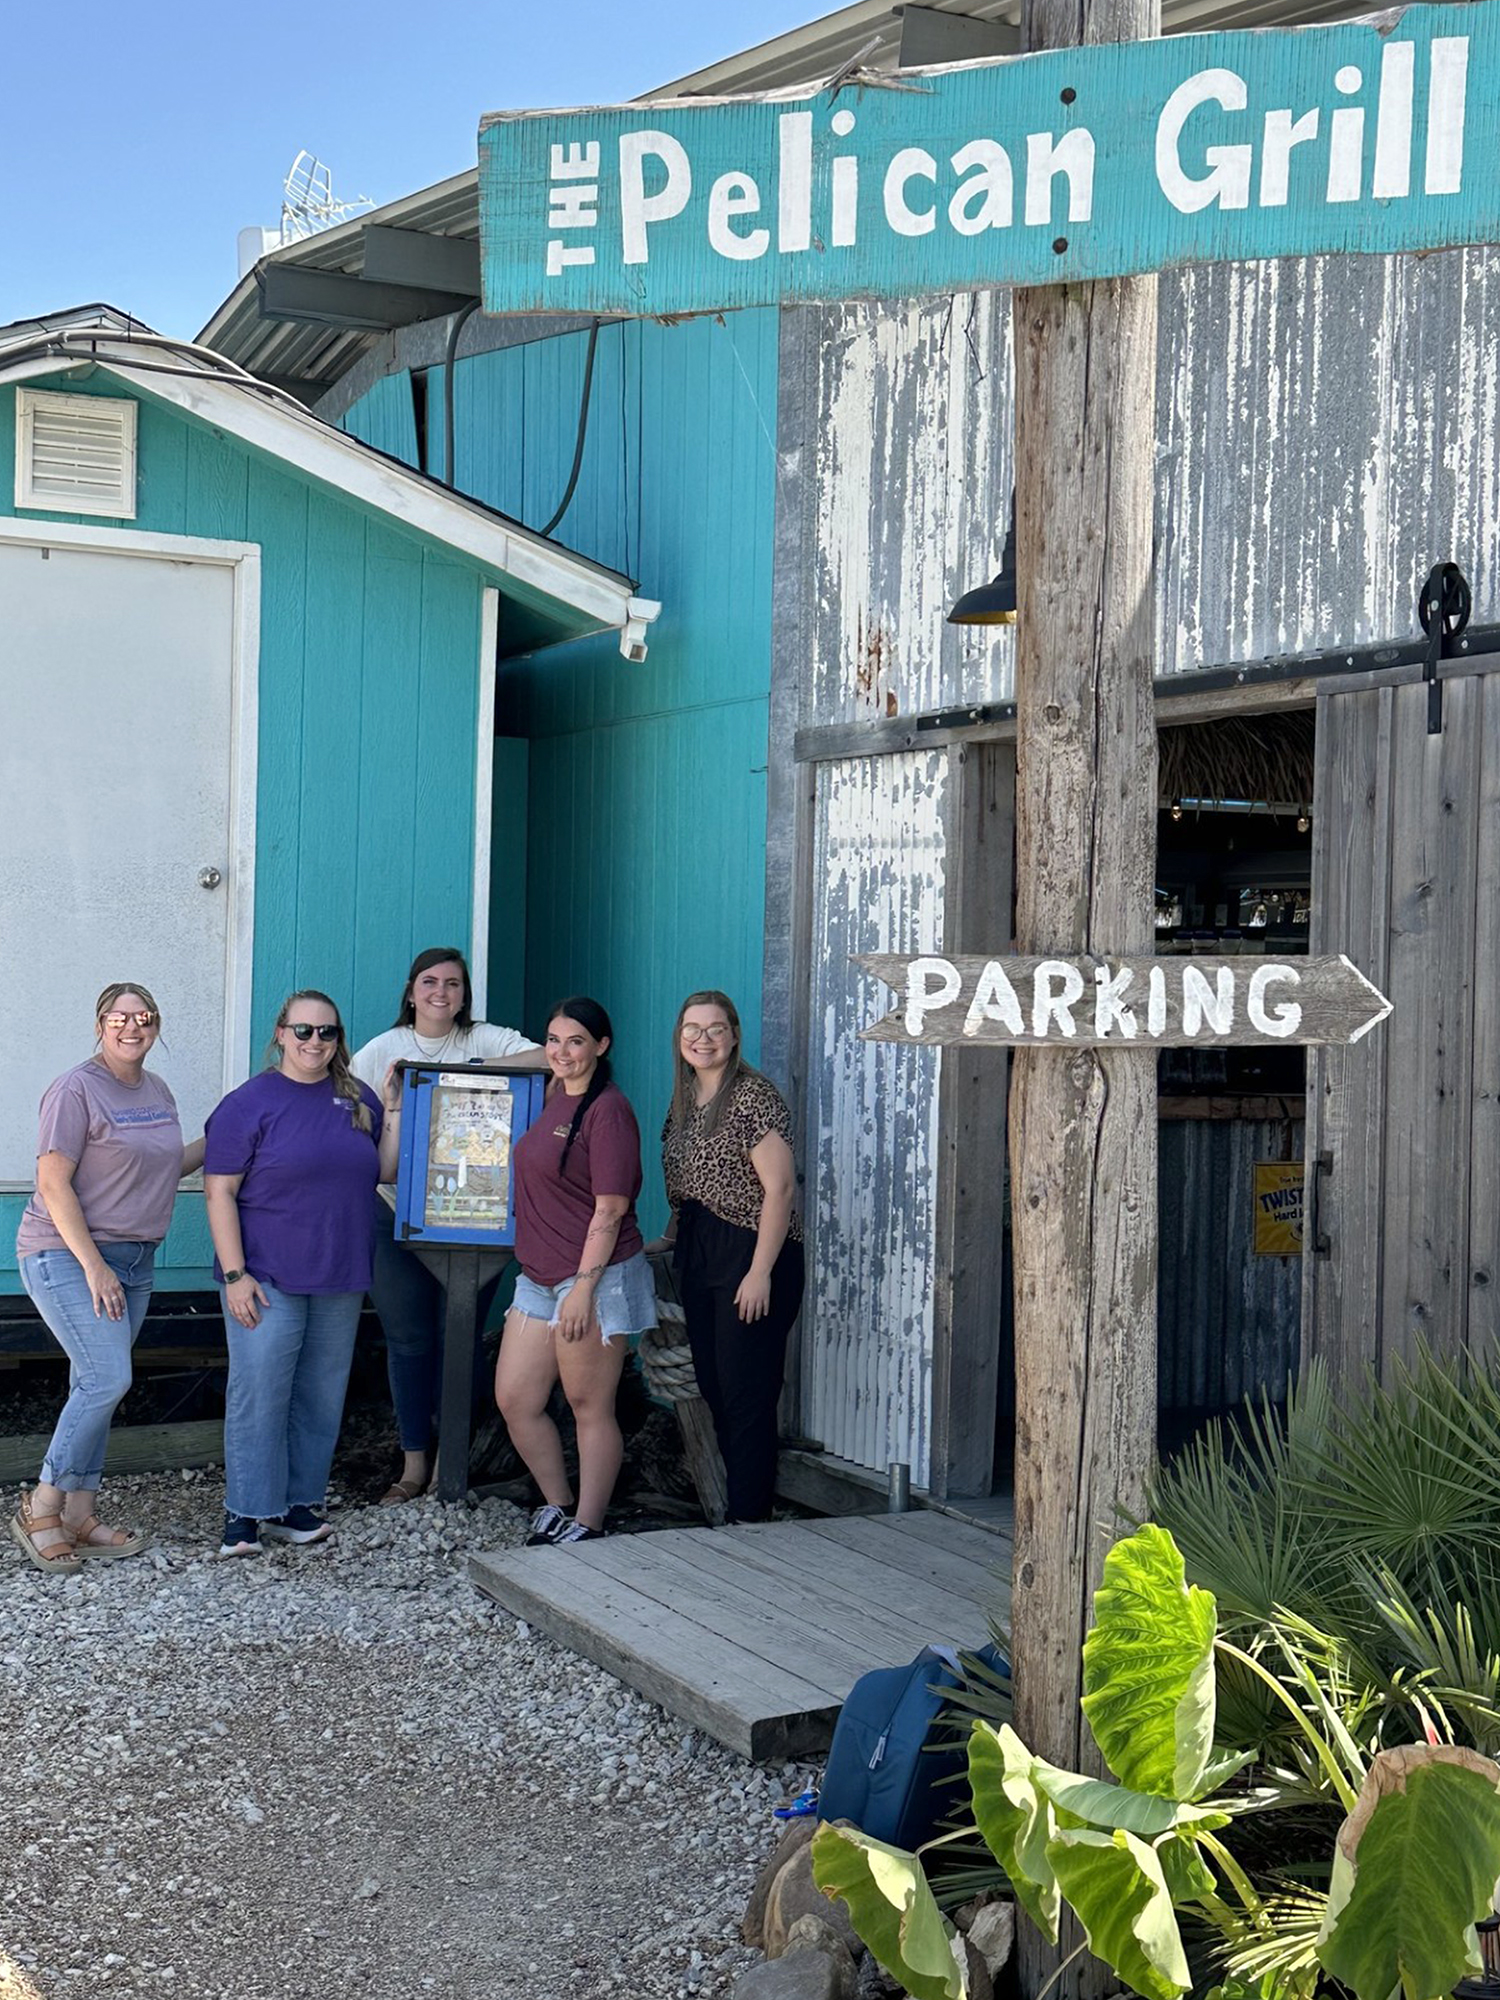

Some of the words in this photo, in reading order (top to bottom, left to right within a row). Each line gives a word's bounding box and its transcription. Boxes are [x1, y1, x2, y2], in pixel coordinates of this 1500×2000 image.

[546, 140, 600, 276] THE
[618, 110, 1096, 265] Pelican
[1154, 35, 1470, 214] Grill
[904, 957, 1304, 1040] PARKING
